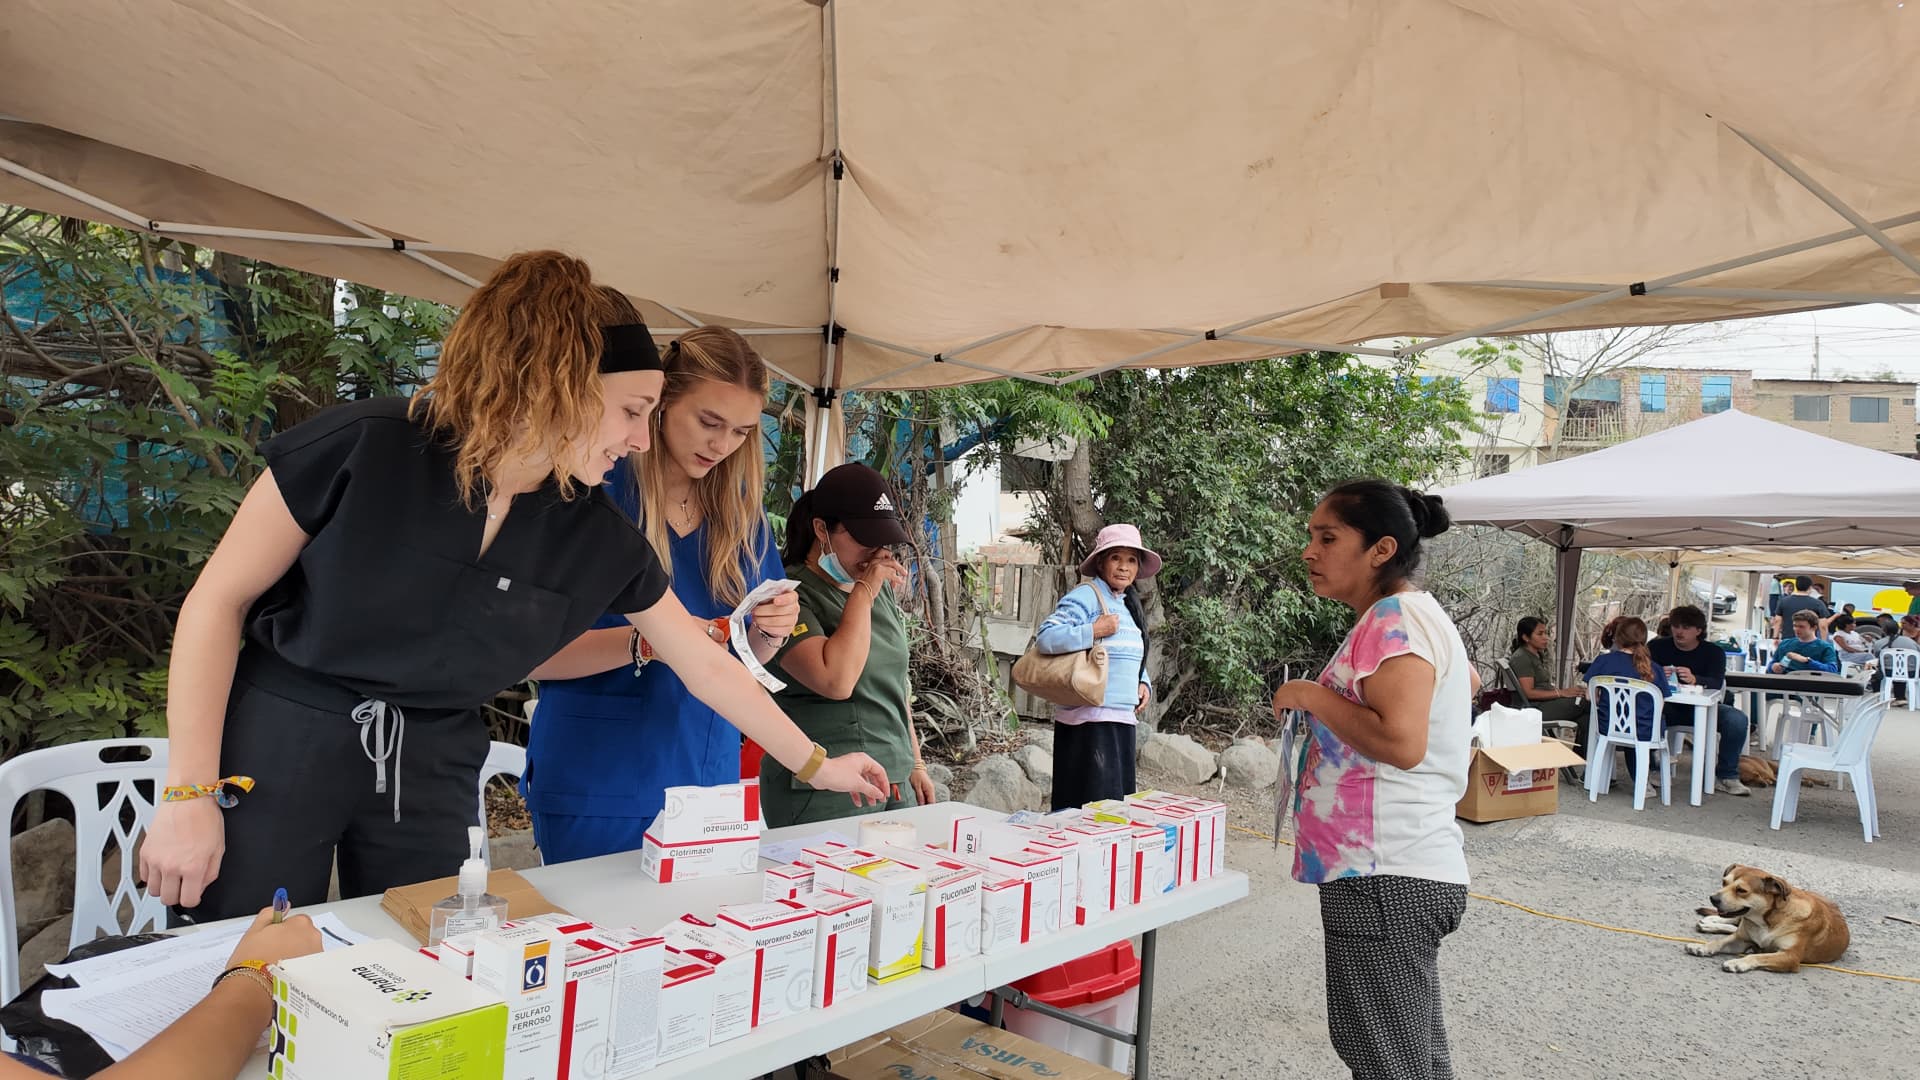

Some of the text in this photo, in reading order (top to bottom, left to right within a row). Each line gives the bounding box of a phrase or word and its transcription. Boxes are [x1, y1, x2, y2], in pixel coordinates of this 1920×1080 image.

[874, 503, 893, 512] adidas
[703, 822, 749, 835] Clotrimazol
[669, 846, 714, 858] Clotrimazol
[1027, 866, 1060, 880] Doxiciclina
[940, 882, 977, 903] Fluconazol
[832, 913, 870, 932] Metronidazol
[755, 932, 791, 948] Naproxeno
[572, 961, 613, 978] Paracetamol
[514, 1005, 551, 1021] SULFATO
[512, 1014, 552, 1032] FERROSO
